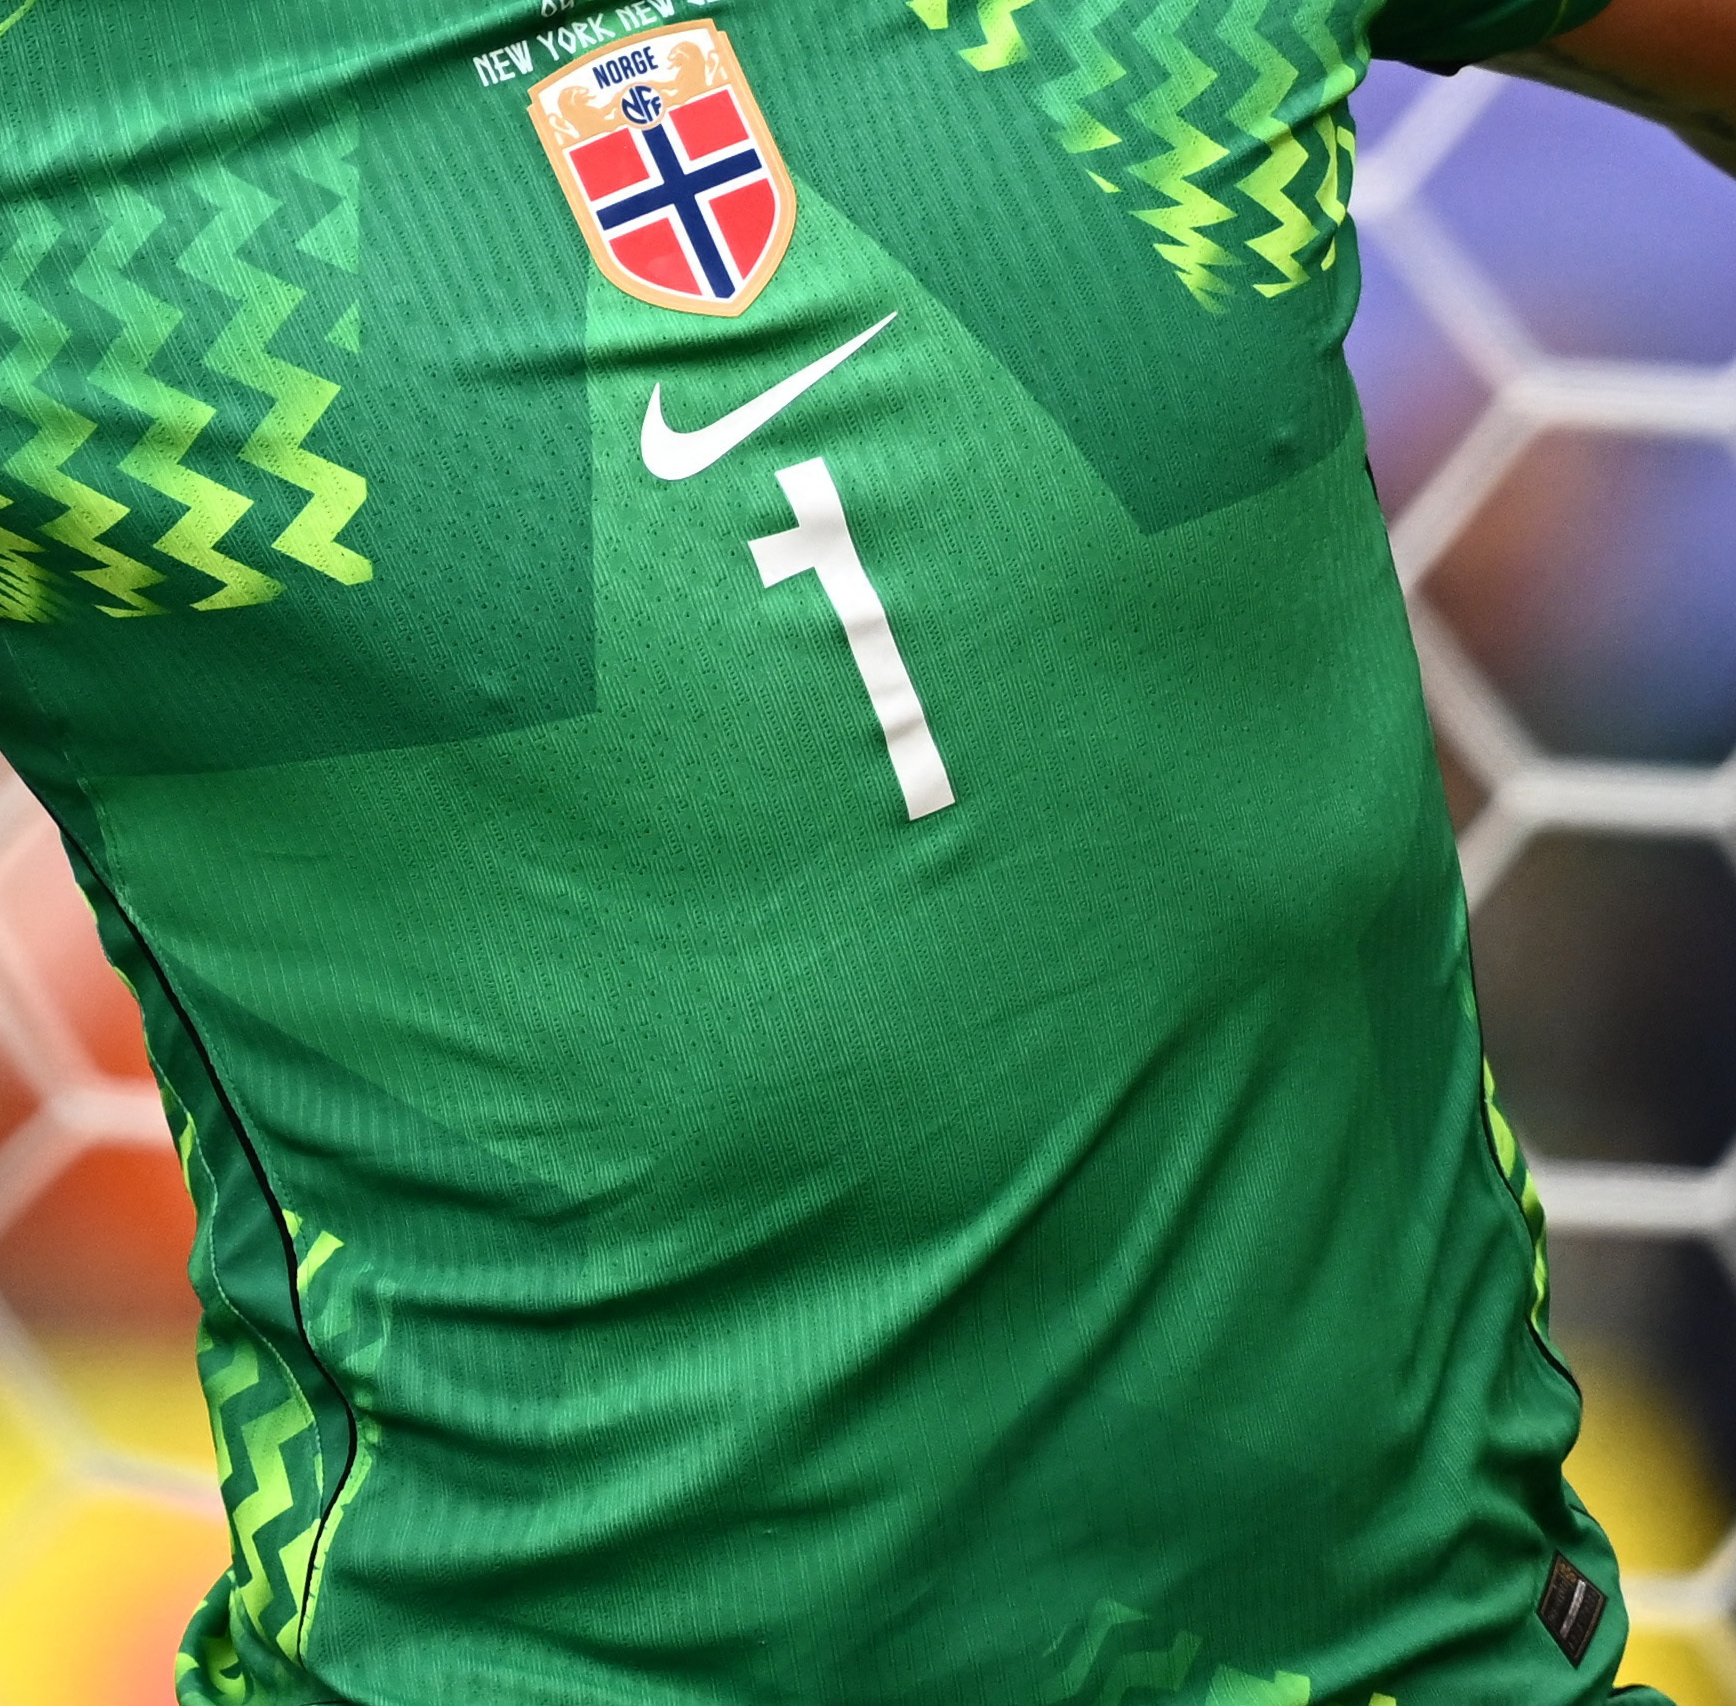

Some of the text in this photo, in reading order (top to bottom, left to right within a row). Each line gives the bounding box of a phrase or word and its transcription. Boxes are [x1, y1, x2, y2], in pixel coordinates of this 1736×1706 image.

[472, 40, 534, 87] NEW
[536, 13, 616, 61] YORK
[592, 46, 659, 89] NORGE
[747, 456, 956, 821] 1
